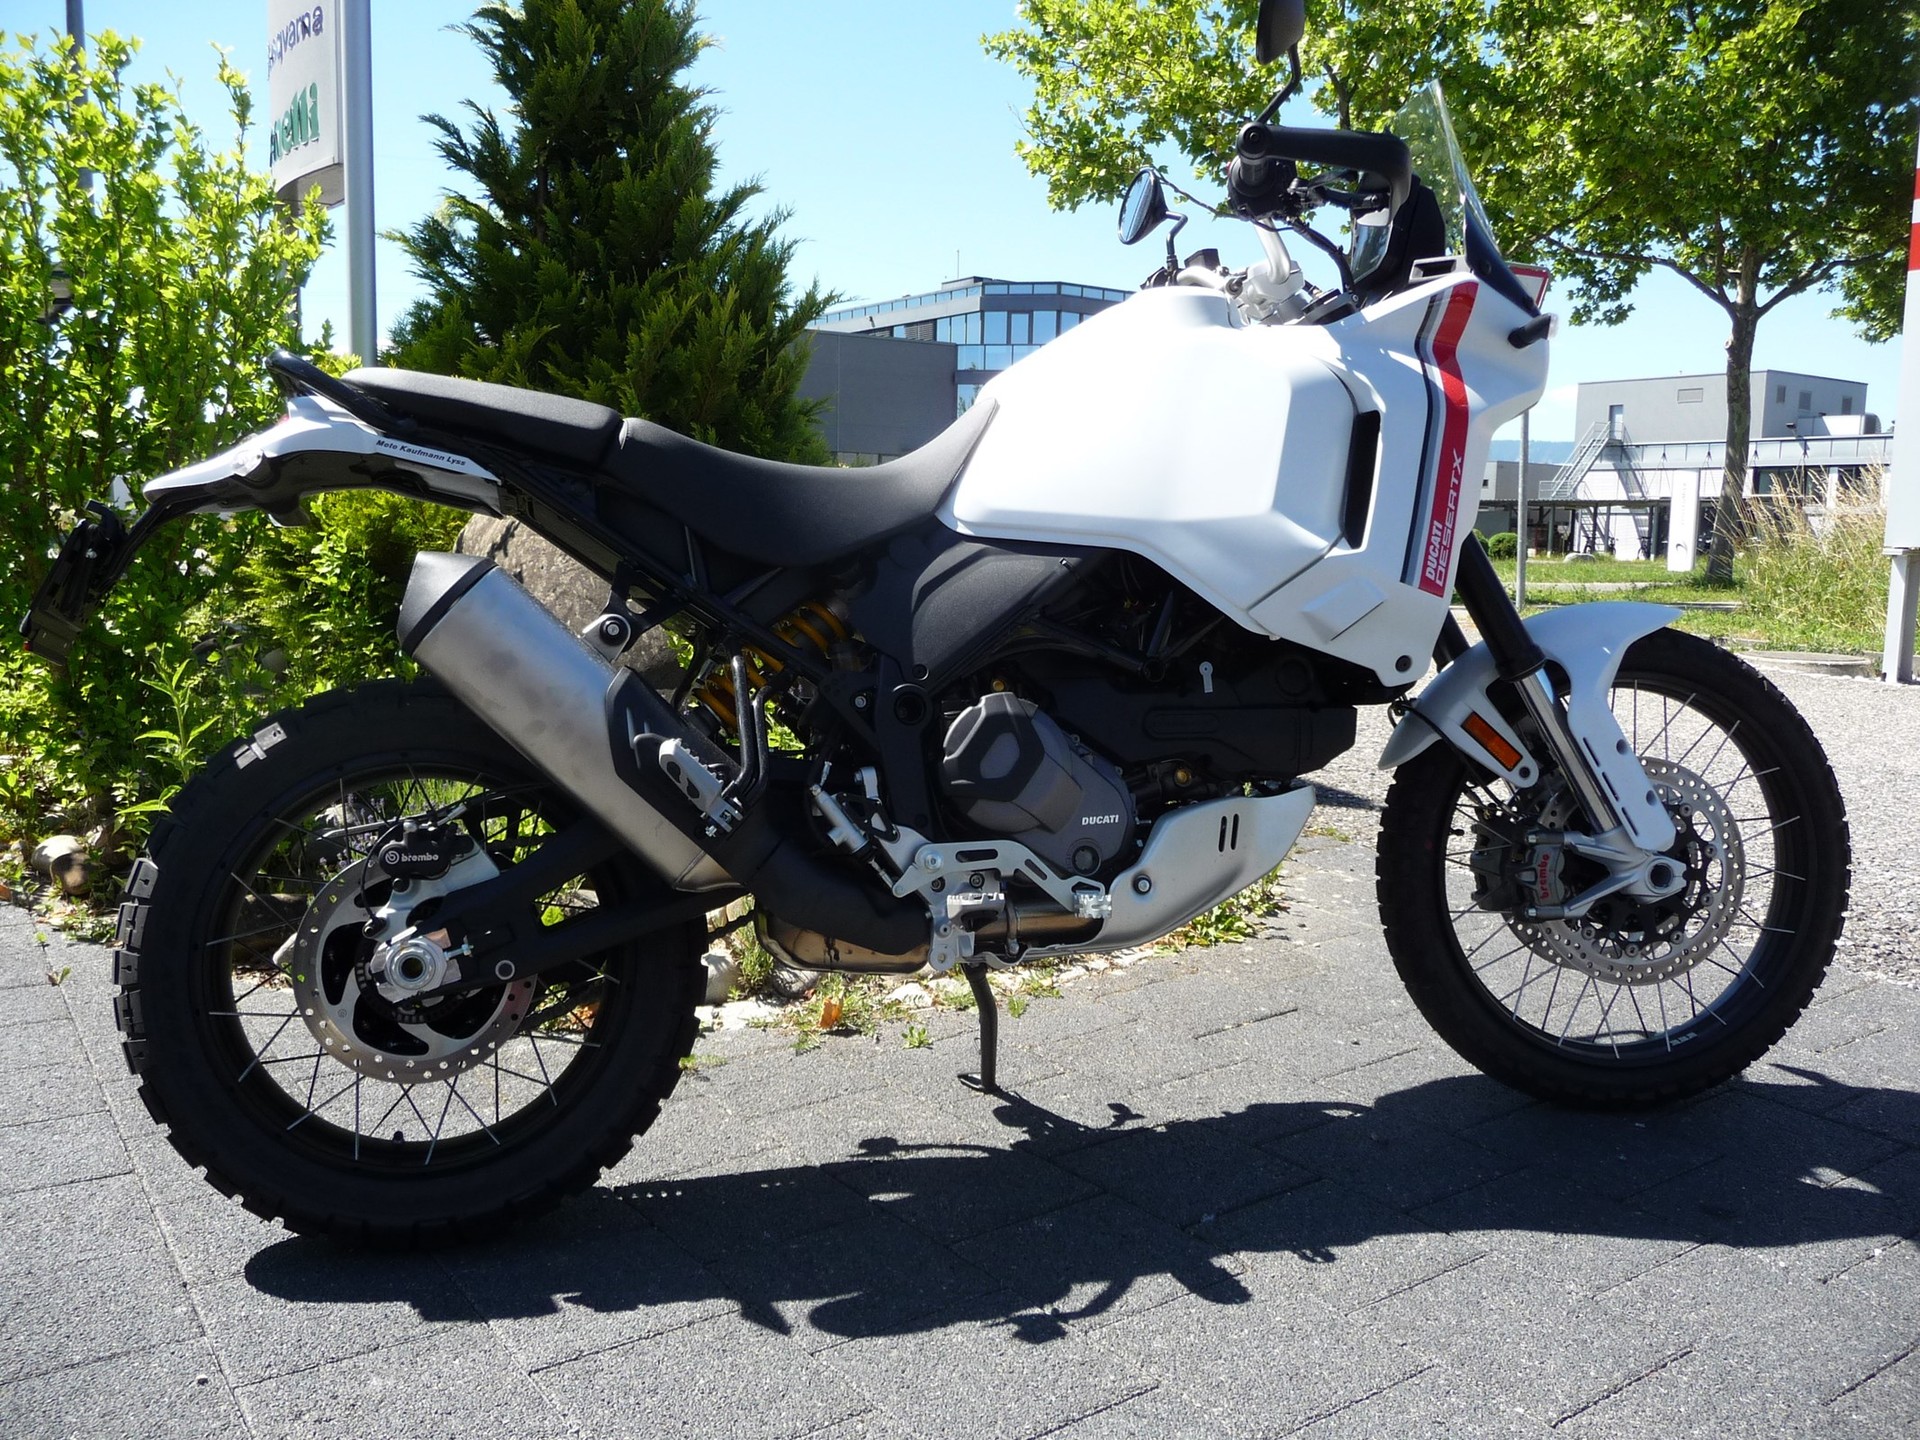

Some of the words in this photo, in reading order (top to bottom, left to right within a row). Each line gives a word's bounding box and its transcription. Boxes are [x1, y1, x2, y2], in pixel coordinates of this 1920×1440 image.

[376, 440, 398, 450] Moto
[400, 445, 445, 461] Kaufmann
[446, 456, 466, 466] Lyss
[1435, 448, 1463, 587] DESERTX
[1425, 520, 1443, 581] DUCATI
[1081, 814, 1119, 826] DUCATI
[401, 852, 439, 862] brembo
[1538, 854, 1550, 899] brembo
